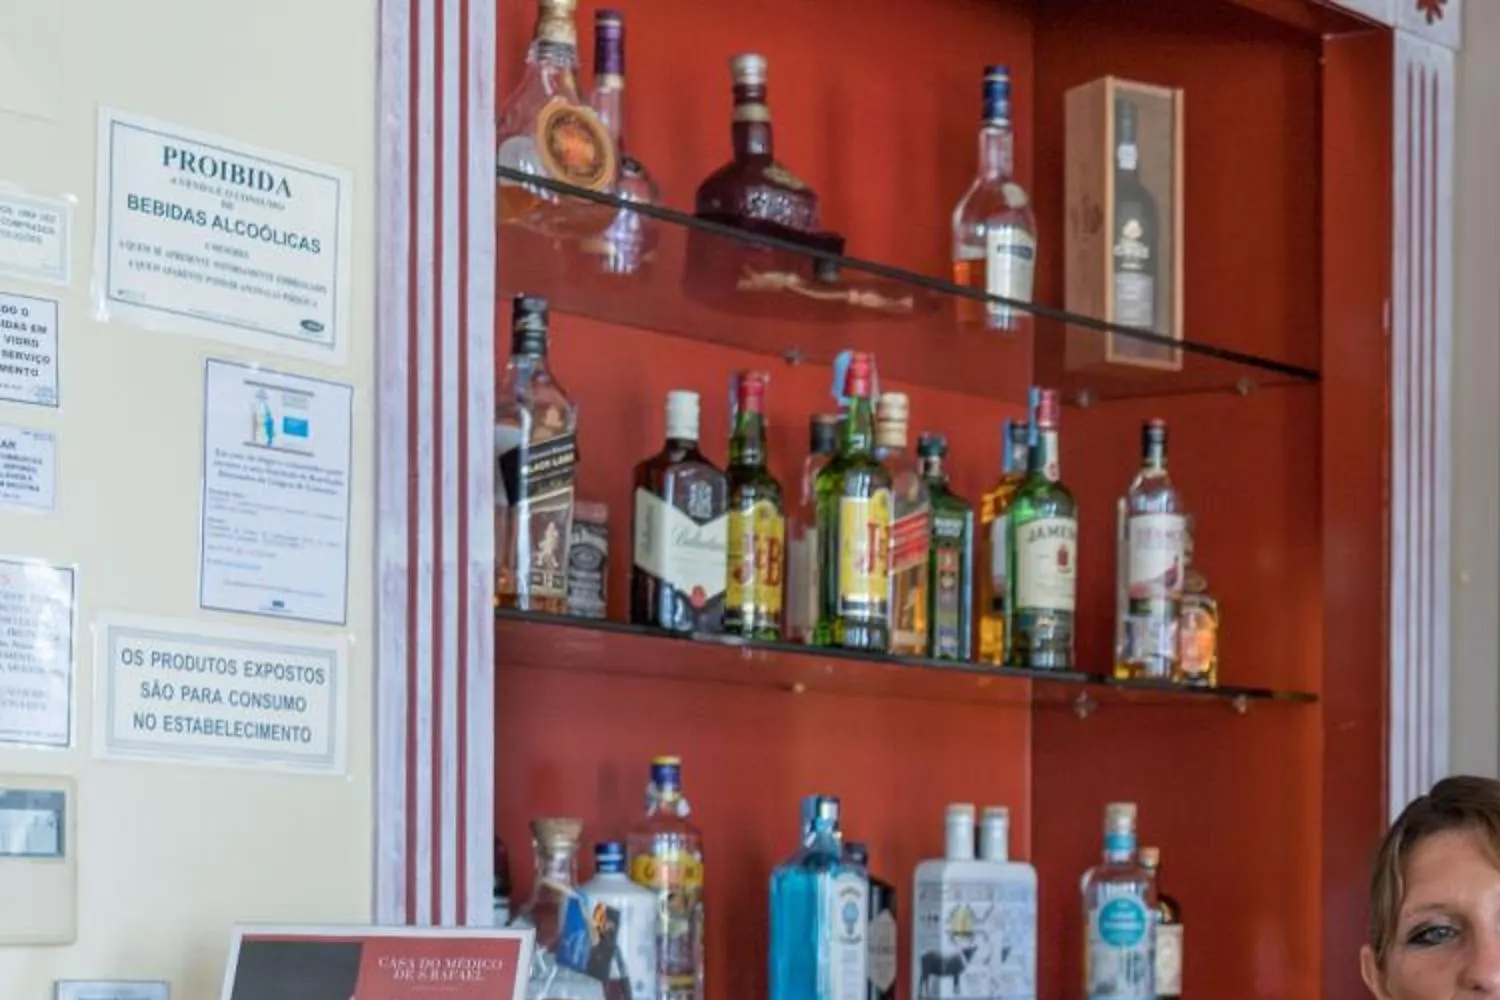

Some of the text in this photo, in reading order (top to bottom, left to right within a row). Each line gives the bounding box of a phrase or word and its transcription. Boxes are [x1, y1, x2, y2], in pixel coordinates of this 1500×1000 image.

[162, 145, 293, 199] PROIBIDA
[127, 193, 321, 255] BEBIDAS ALCOÓLICAS
[121, 648, 326, 686] OS PRODUTOS EXPOSTOS
[181, 685, 223, 705] PARA
[228, 689, 307, 713] CONSUMO
[133, 712, 312, 744] NO ESTABELECIMENTO
